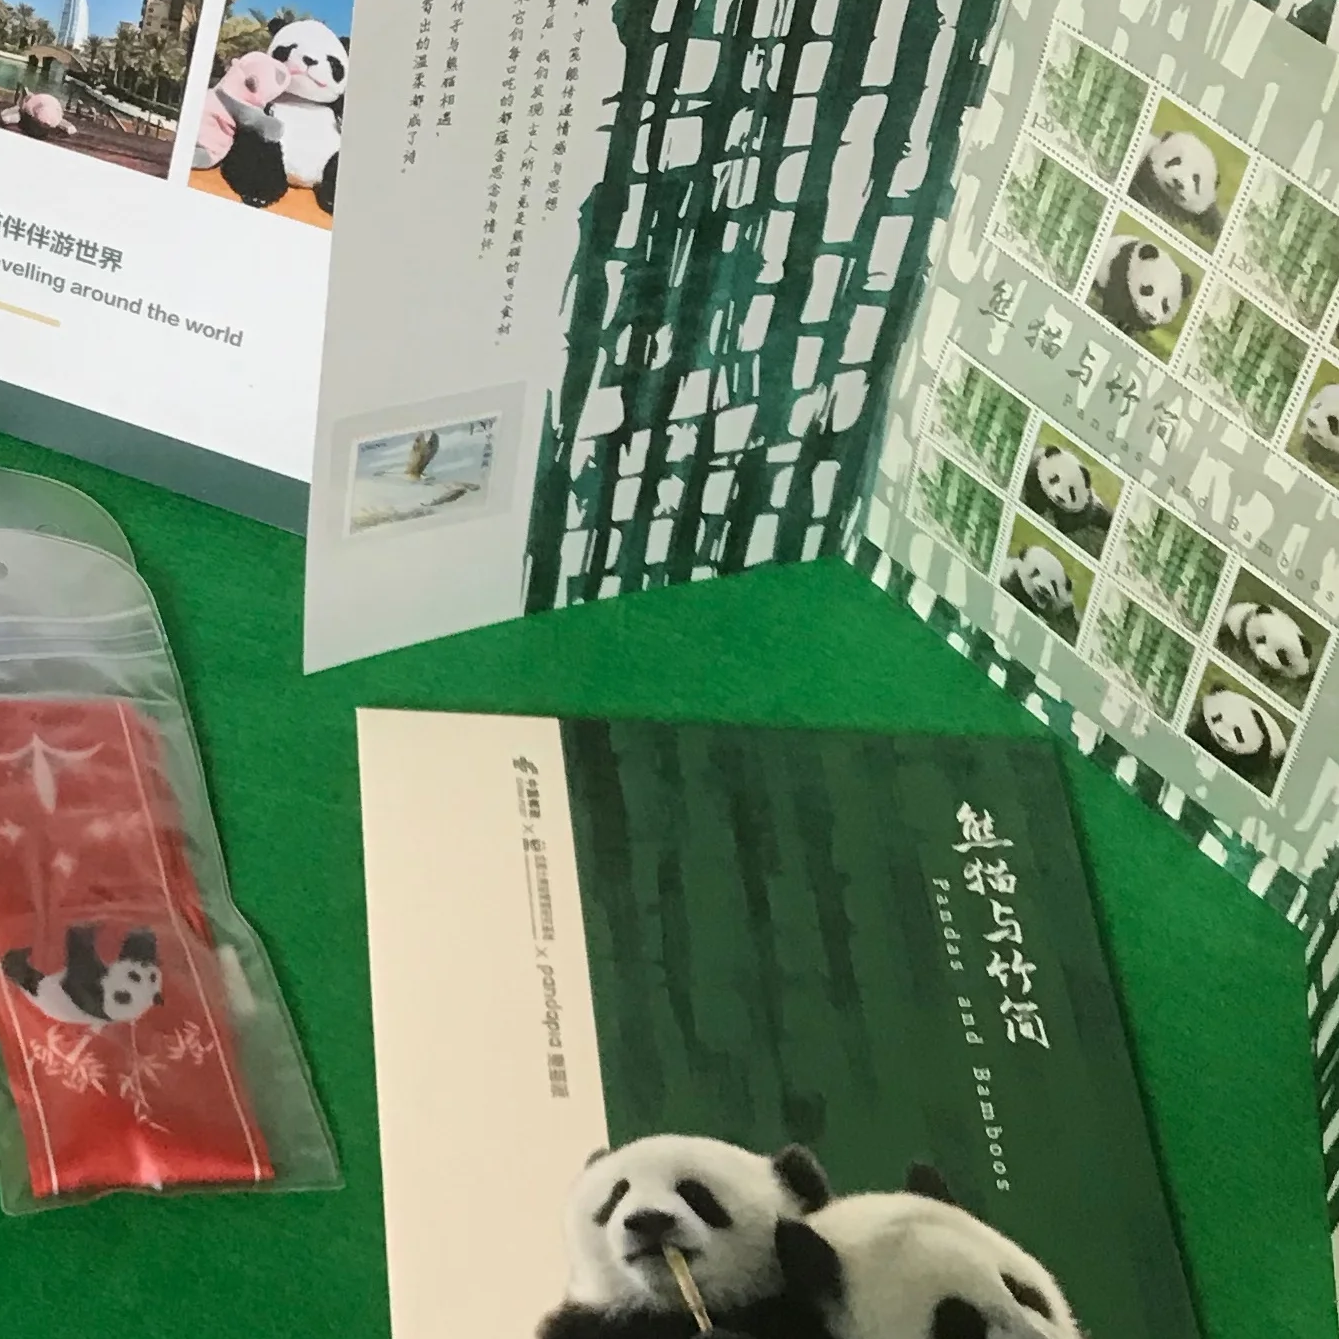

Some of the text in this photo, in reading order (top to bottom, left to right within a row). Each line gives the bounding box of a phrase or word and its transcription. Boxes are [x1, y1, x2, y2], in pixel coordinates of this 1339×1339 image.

[71, 278, 143, 316] around
[147, 301, 181, 329] the
[184, 315, 244, 348] world
[1061, 395, 1144, 464] Pandas
[536, 964, 563, 1048] pandapia
[932, 877, 1010, 1193] Pandas and Bamboos
